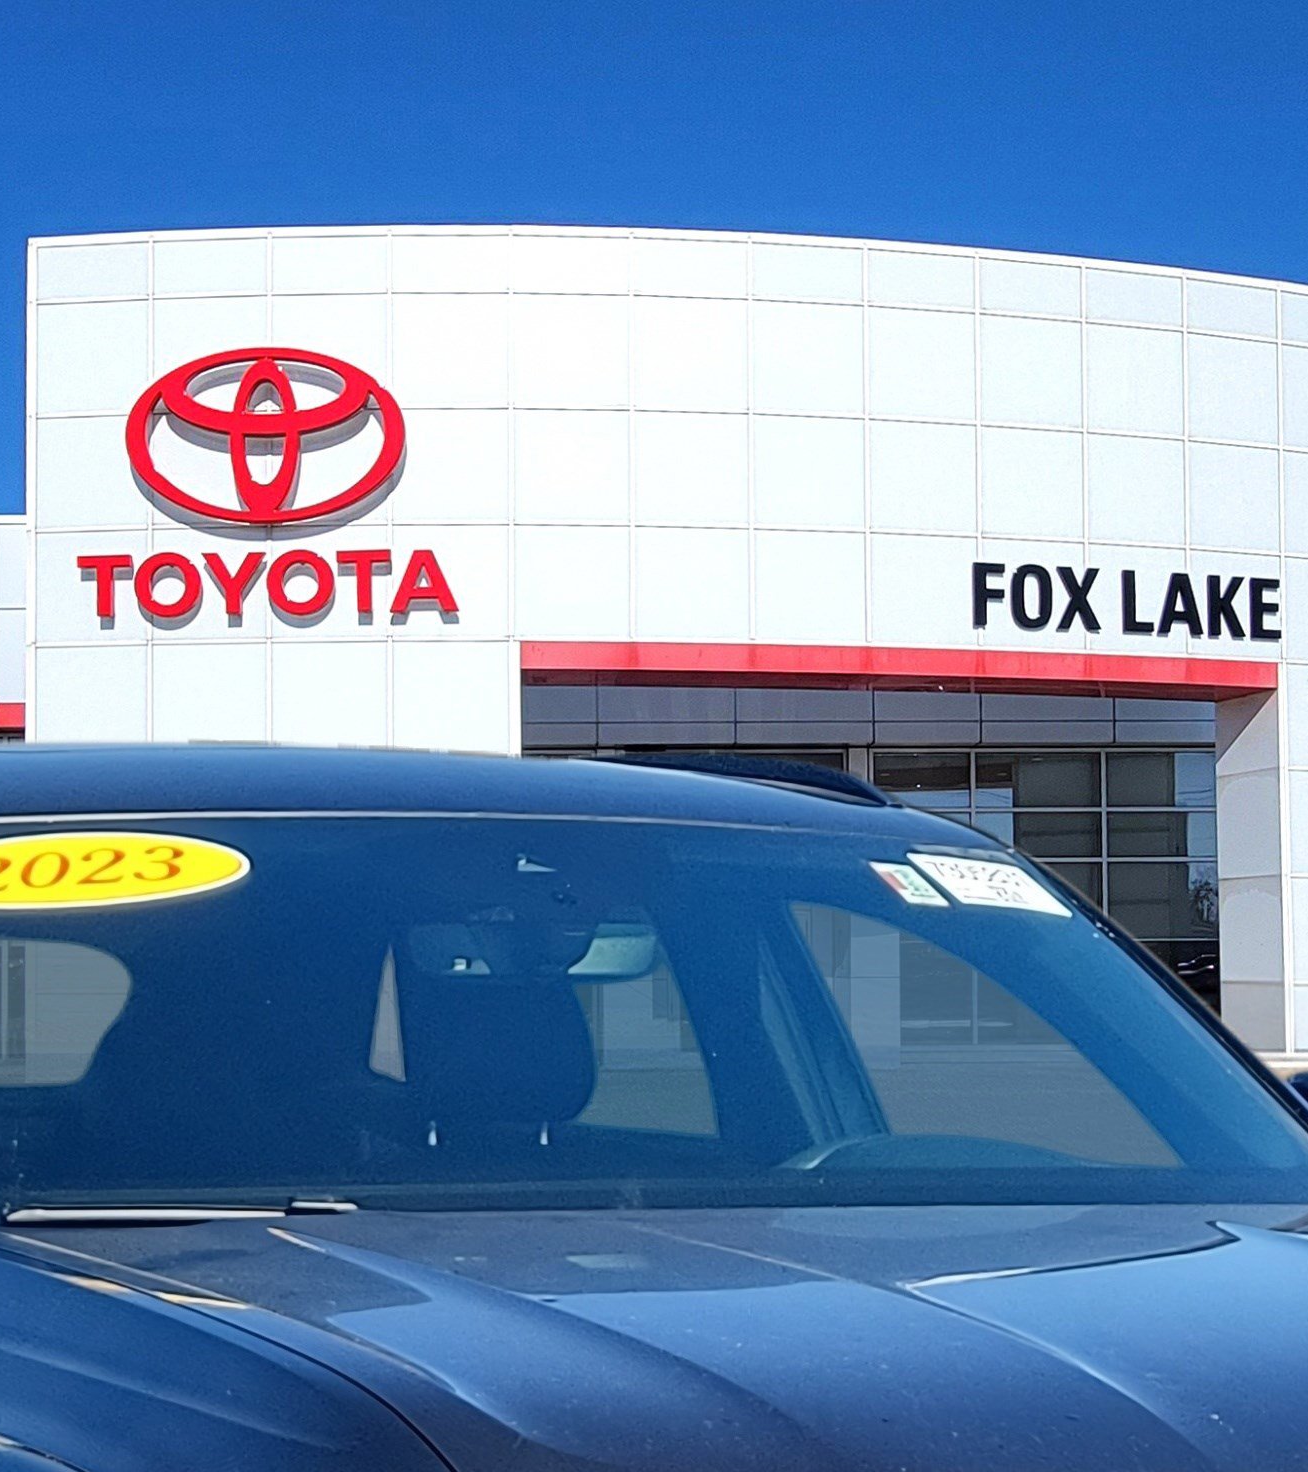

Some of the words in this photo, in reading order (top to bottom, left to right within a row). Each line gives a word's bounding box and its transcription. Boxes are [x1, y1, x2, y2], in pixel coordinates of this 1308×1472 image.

[77, 549, 460, 624] TOYOTA
[972, 562, 1102, 634] FOX
[1121, 569, 1282, 641] LAKE
